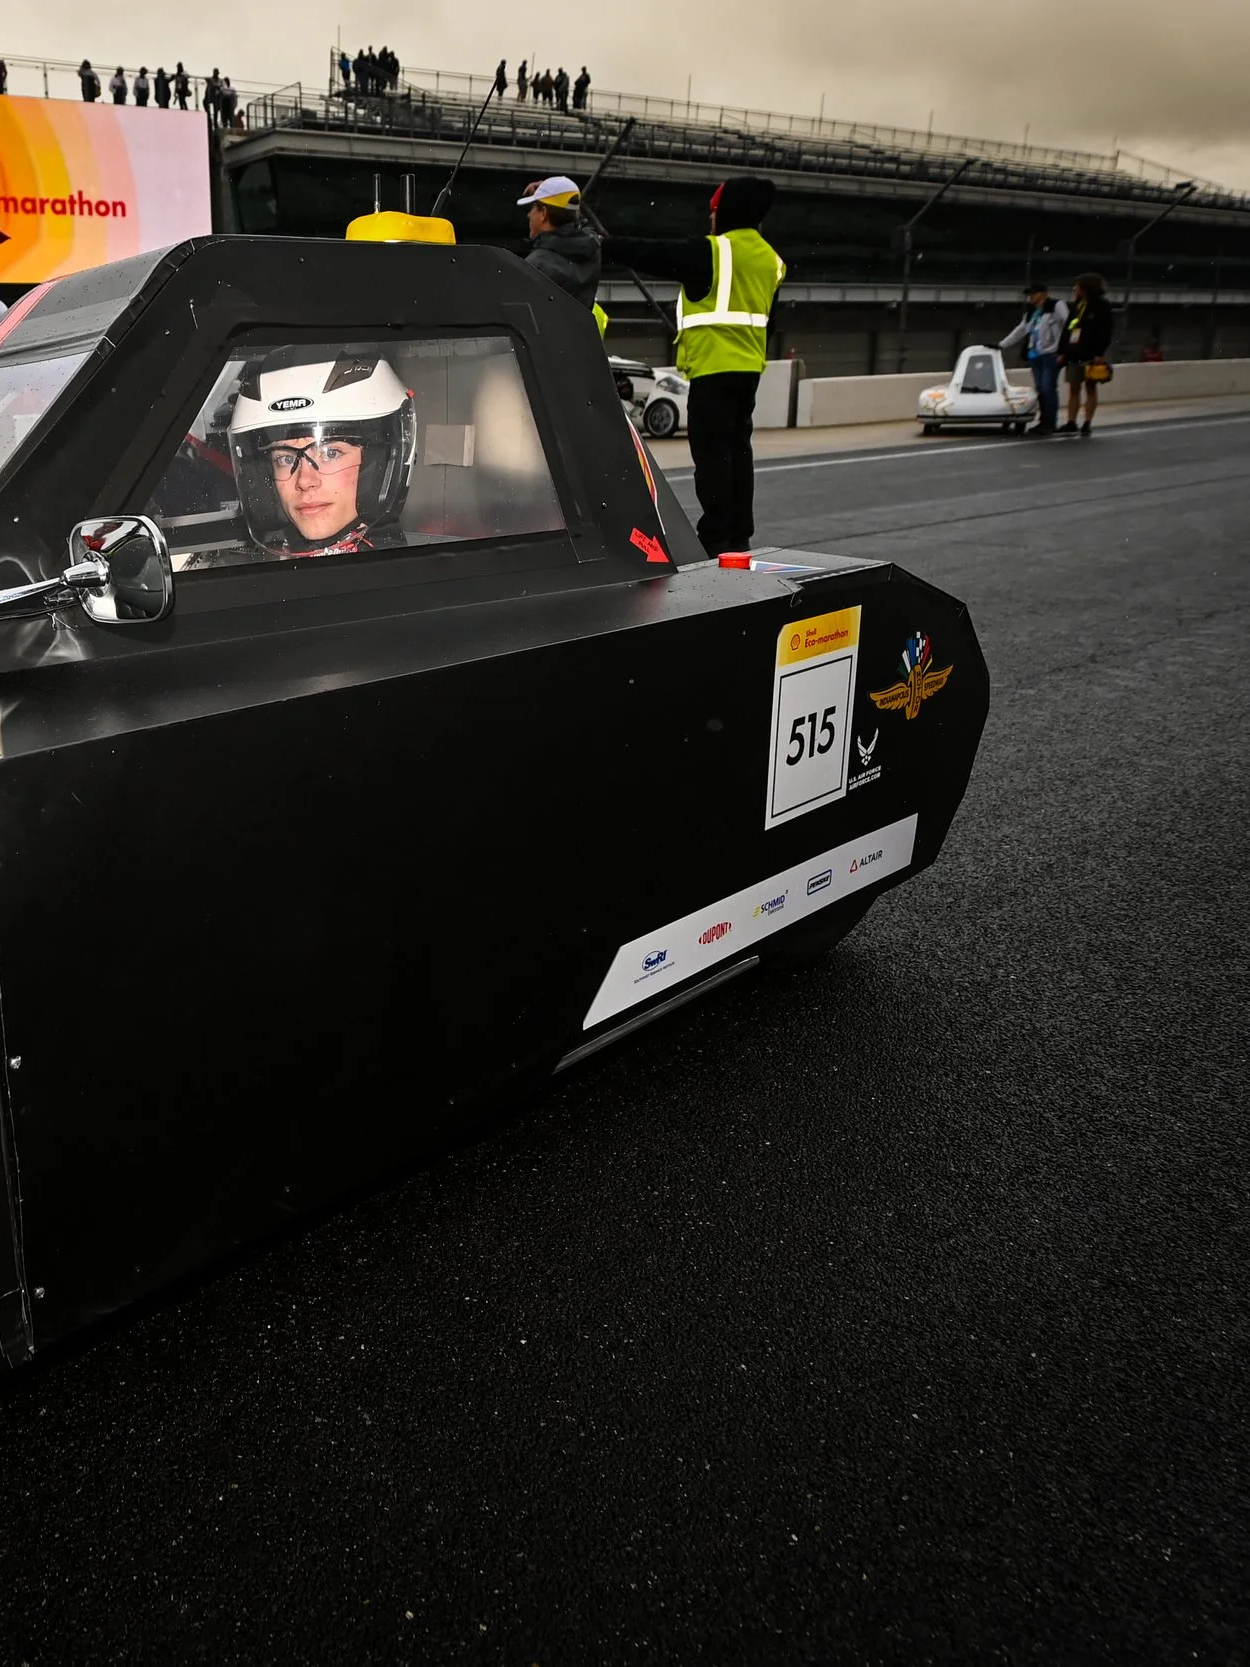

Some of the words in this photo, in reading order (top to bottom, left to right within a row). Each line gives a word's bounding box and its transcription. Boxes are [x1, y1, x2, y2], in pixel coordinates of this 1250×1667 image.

[804, 628, 849, 649] Eco-marathon
[805, 627, 818, 638] Shell
[786, 705, 837, 766] 515
[859, 850, 883, 868] ALTAIR
[760, 895, 786, 914] SCHMID
[702, 921, 729, 945] DUPONT
